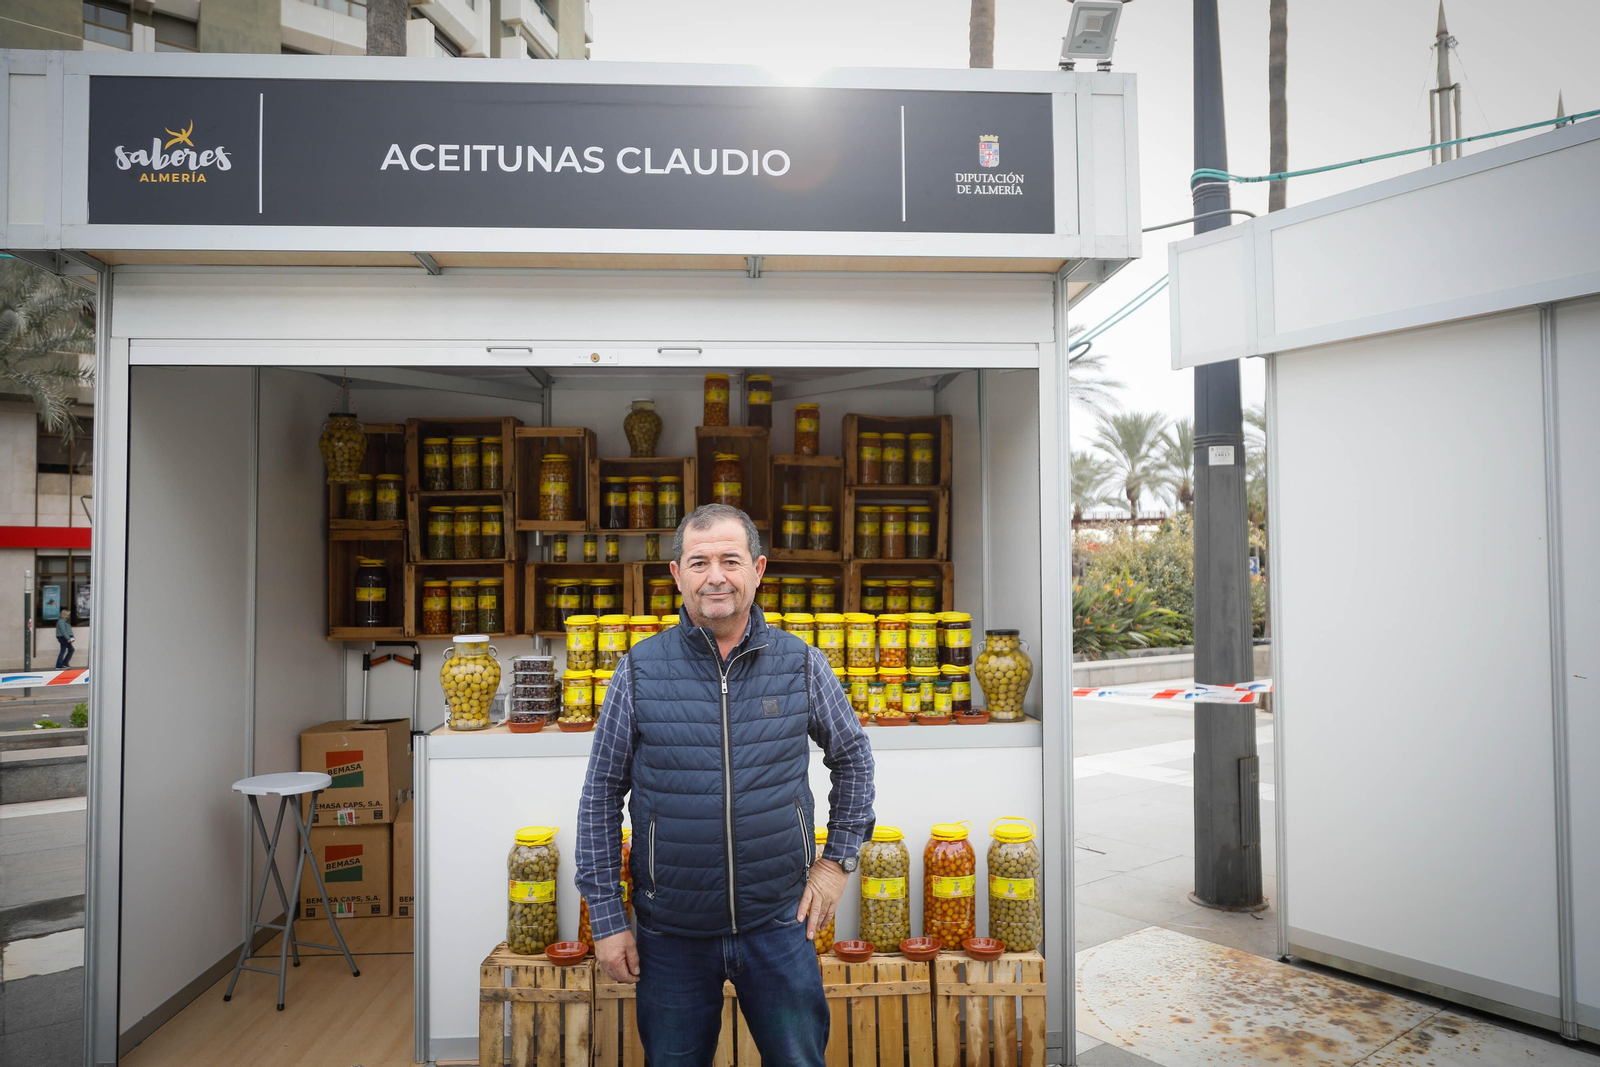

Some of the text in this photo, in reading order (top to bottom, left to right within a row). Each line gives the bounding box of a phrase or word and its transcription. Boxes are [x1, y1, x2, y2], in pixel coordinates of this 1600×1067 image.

[380, 143, 792, 177] ACEITUNAS CLAUDIO
[139, 170, 207, 183] ALMERÍA
[955, 171, 1025, 184] DIPUTACIÓN
[956, 184, 1024, 196] DE ALMERÍA
[327, 763, 362, 776] BEMASA
[309, 802, 341, 810] EMASA
[325, 857, 361, 870] BEMASA
[306, 896, 339, 904] BEMSA
